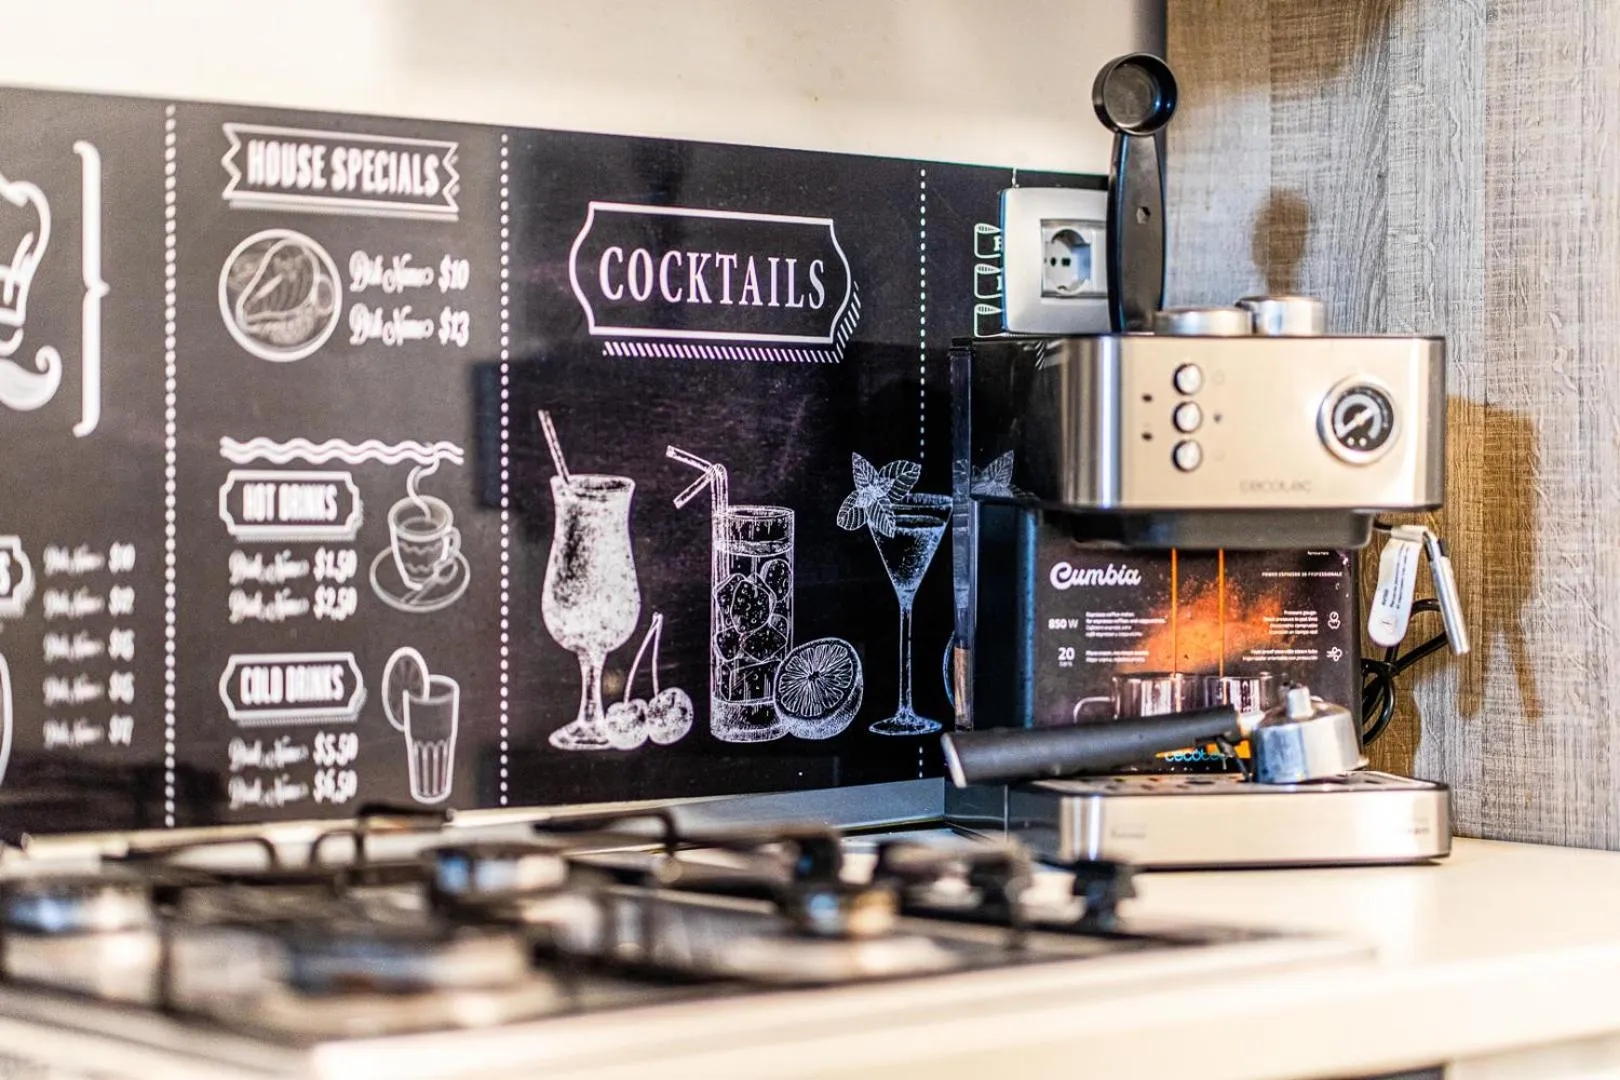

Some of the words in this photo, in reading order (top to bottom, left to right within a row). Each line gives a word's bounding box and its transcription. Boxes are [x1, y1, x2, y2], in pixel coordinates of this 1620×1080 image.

[247, 139, 327, 191] HOUSE
[331, 146, 440, 198] SPECIALS
[600, 246, 825, 310] COCKTAILS
[1050, 561, 1142, 590] Cumbia
[1048, 618, 1067, 630] 850
[1068, 618, 1079, 629] W
[1058, 647, 1075, 661] 20
